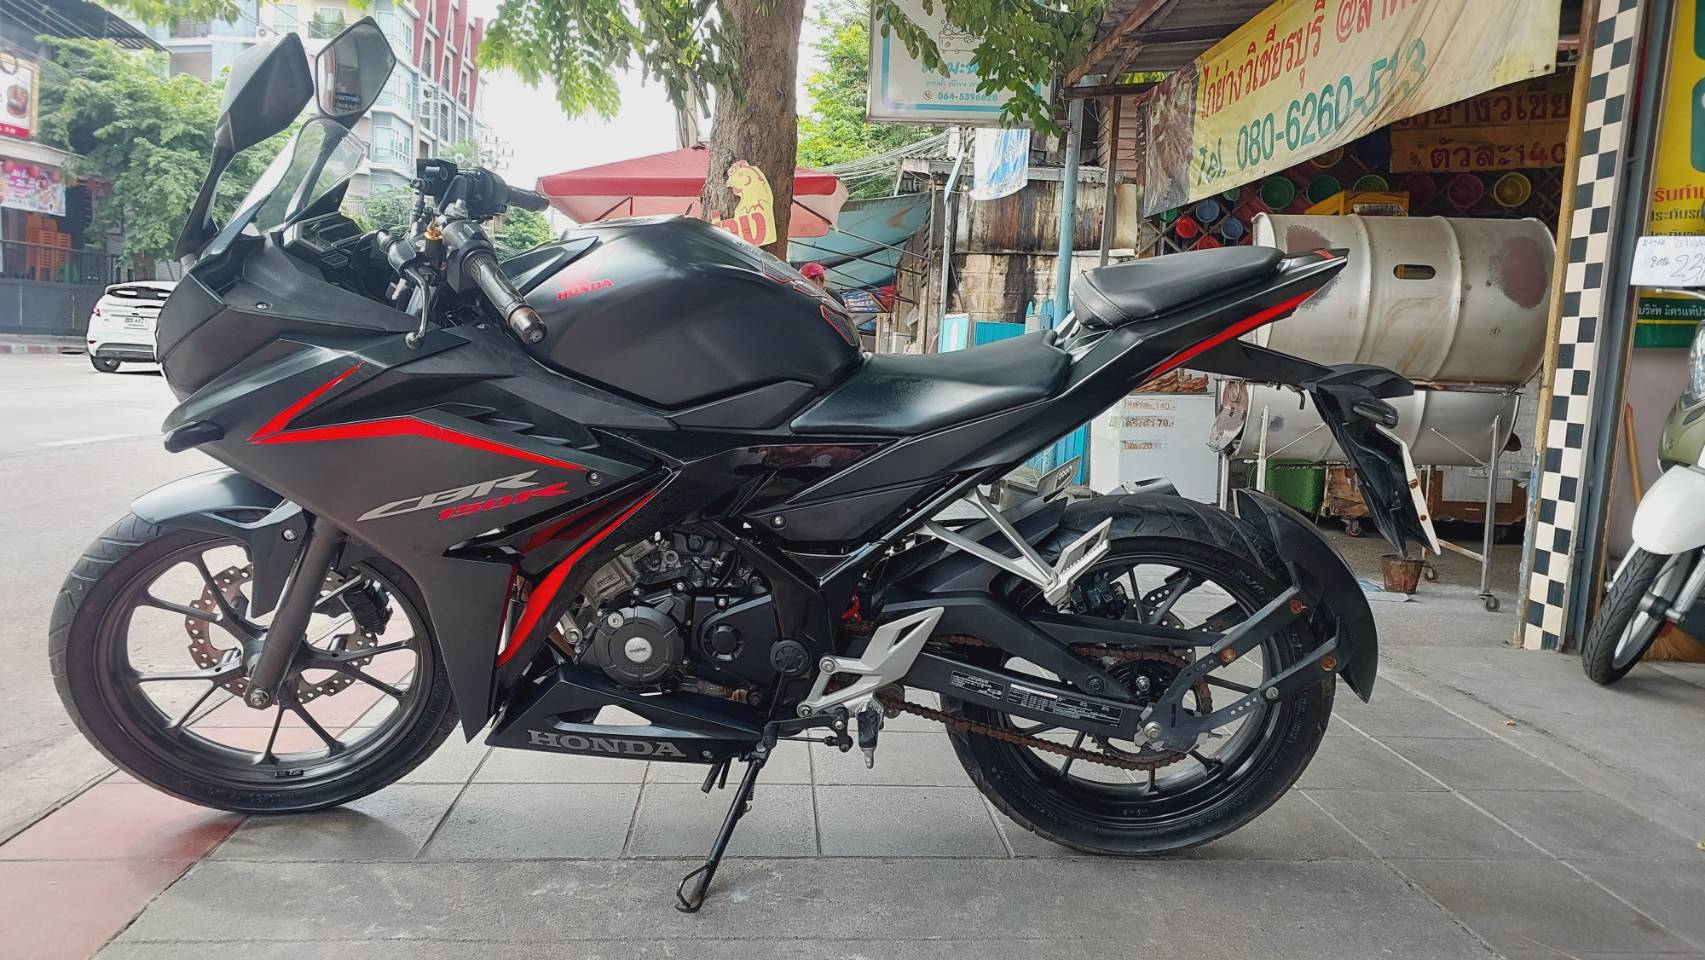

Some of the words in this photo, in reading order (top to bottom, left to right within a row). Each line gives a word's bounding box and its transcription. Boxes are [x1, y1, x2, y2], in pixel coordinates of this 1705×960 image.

[1236, 37, 1427, 171] 080-6260-513
[557, 279, 613, 301] HONDA
[356, 469, 541, 522] CBR
[437, 481, 572, 521] 150R
[527, 729, 687, 758] HONDA
